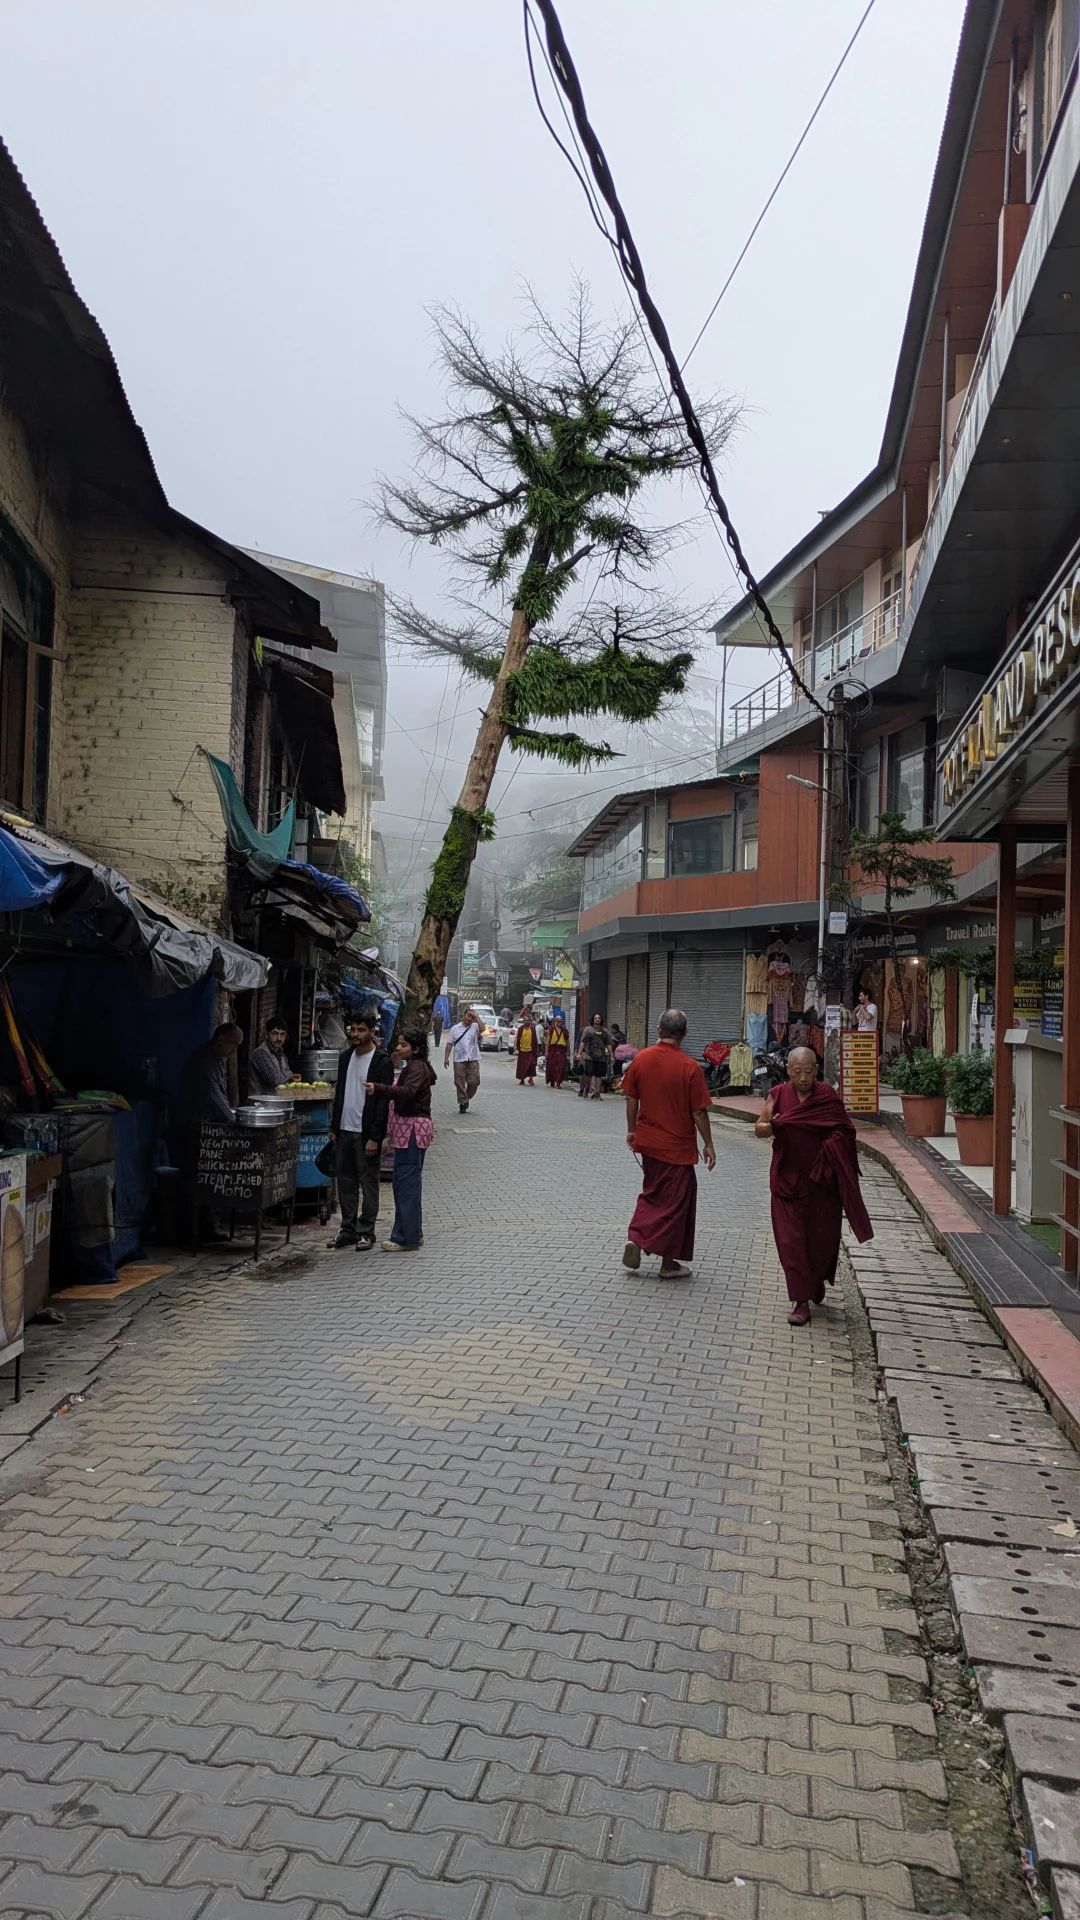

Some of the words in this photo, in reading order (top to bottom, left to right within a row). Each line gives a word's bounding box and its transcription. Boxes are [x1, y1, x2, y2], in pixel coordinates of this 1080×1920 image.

[995, 651, 1035, 745] AND
[945, 925, 971, 940] Travel
[214, 1184, 252, 1199] MOMO
